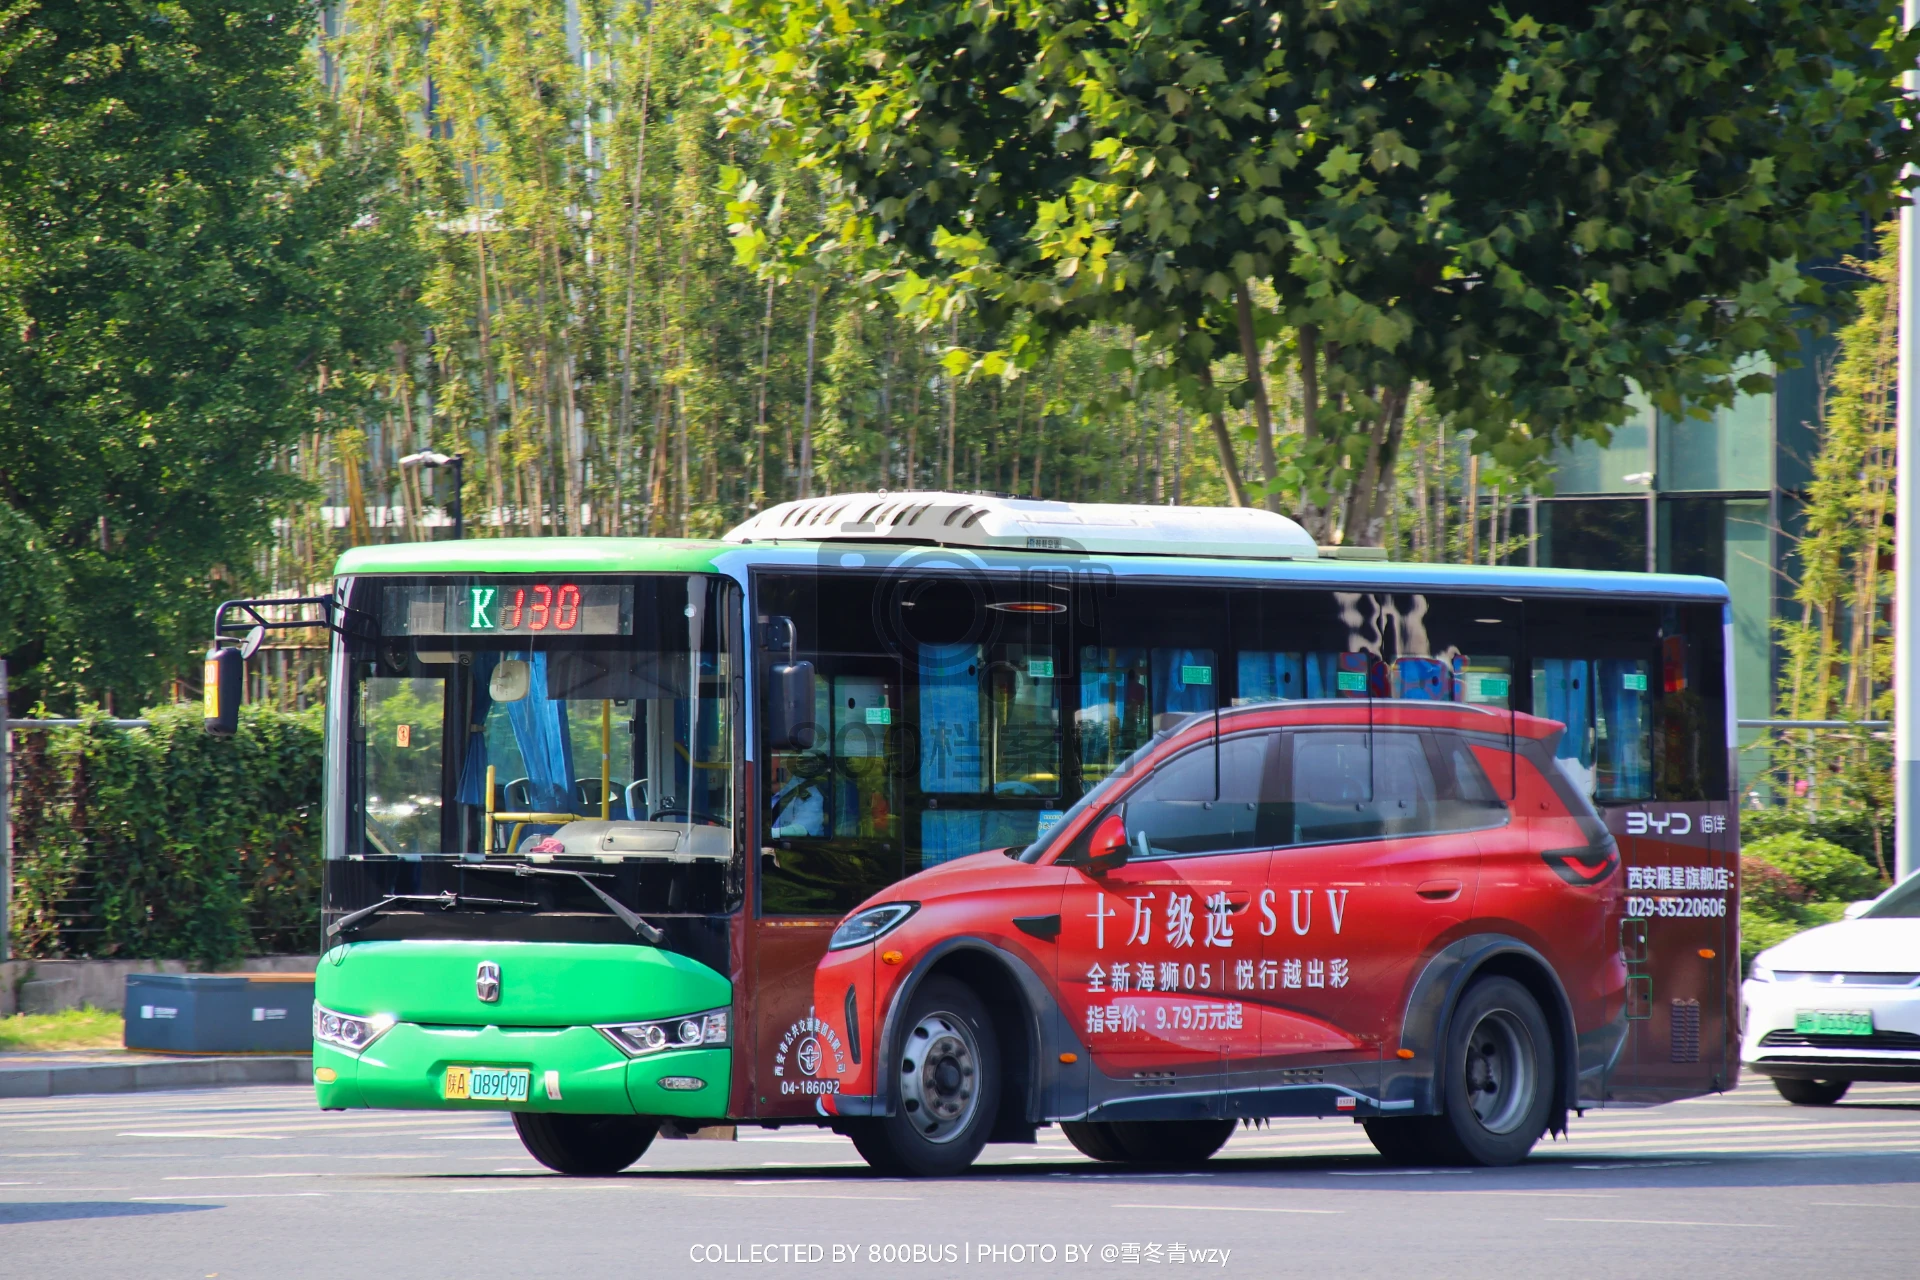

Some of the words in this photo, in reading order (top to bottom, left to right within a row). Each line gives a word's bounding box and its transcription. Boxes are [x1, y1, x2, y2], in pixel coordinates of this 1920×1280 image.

[1626, 812, 1692, 835] BYD
[1700, 815, 1727, 834] 海洋
[1259, 889, 1349, 936] SUV
[1628, 898, 1727, 917] 029-85220606
[1236, 957, 1350, 991] 悦行越出彩
[781, 1080, 840, 1095] 04-186092
